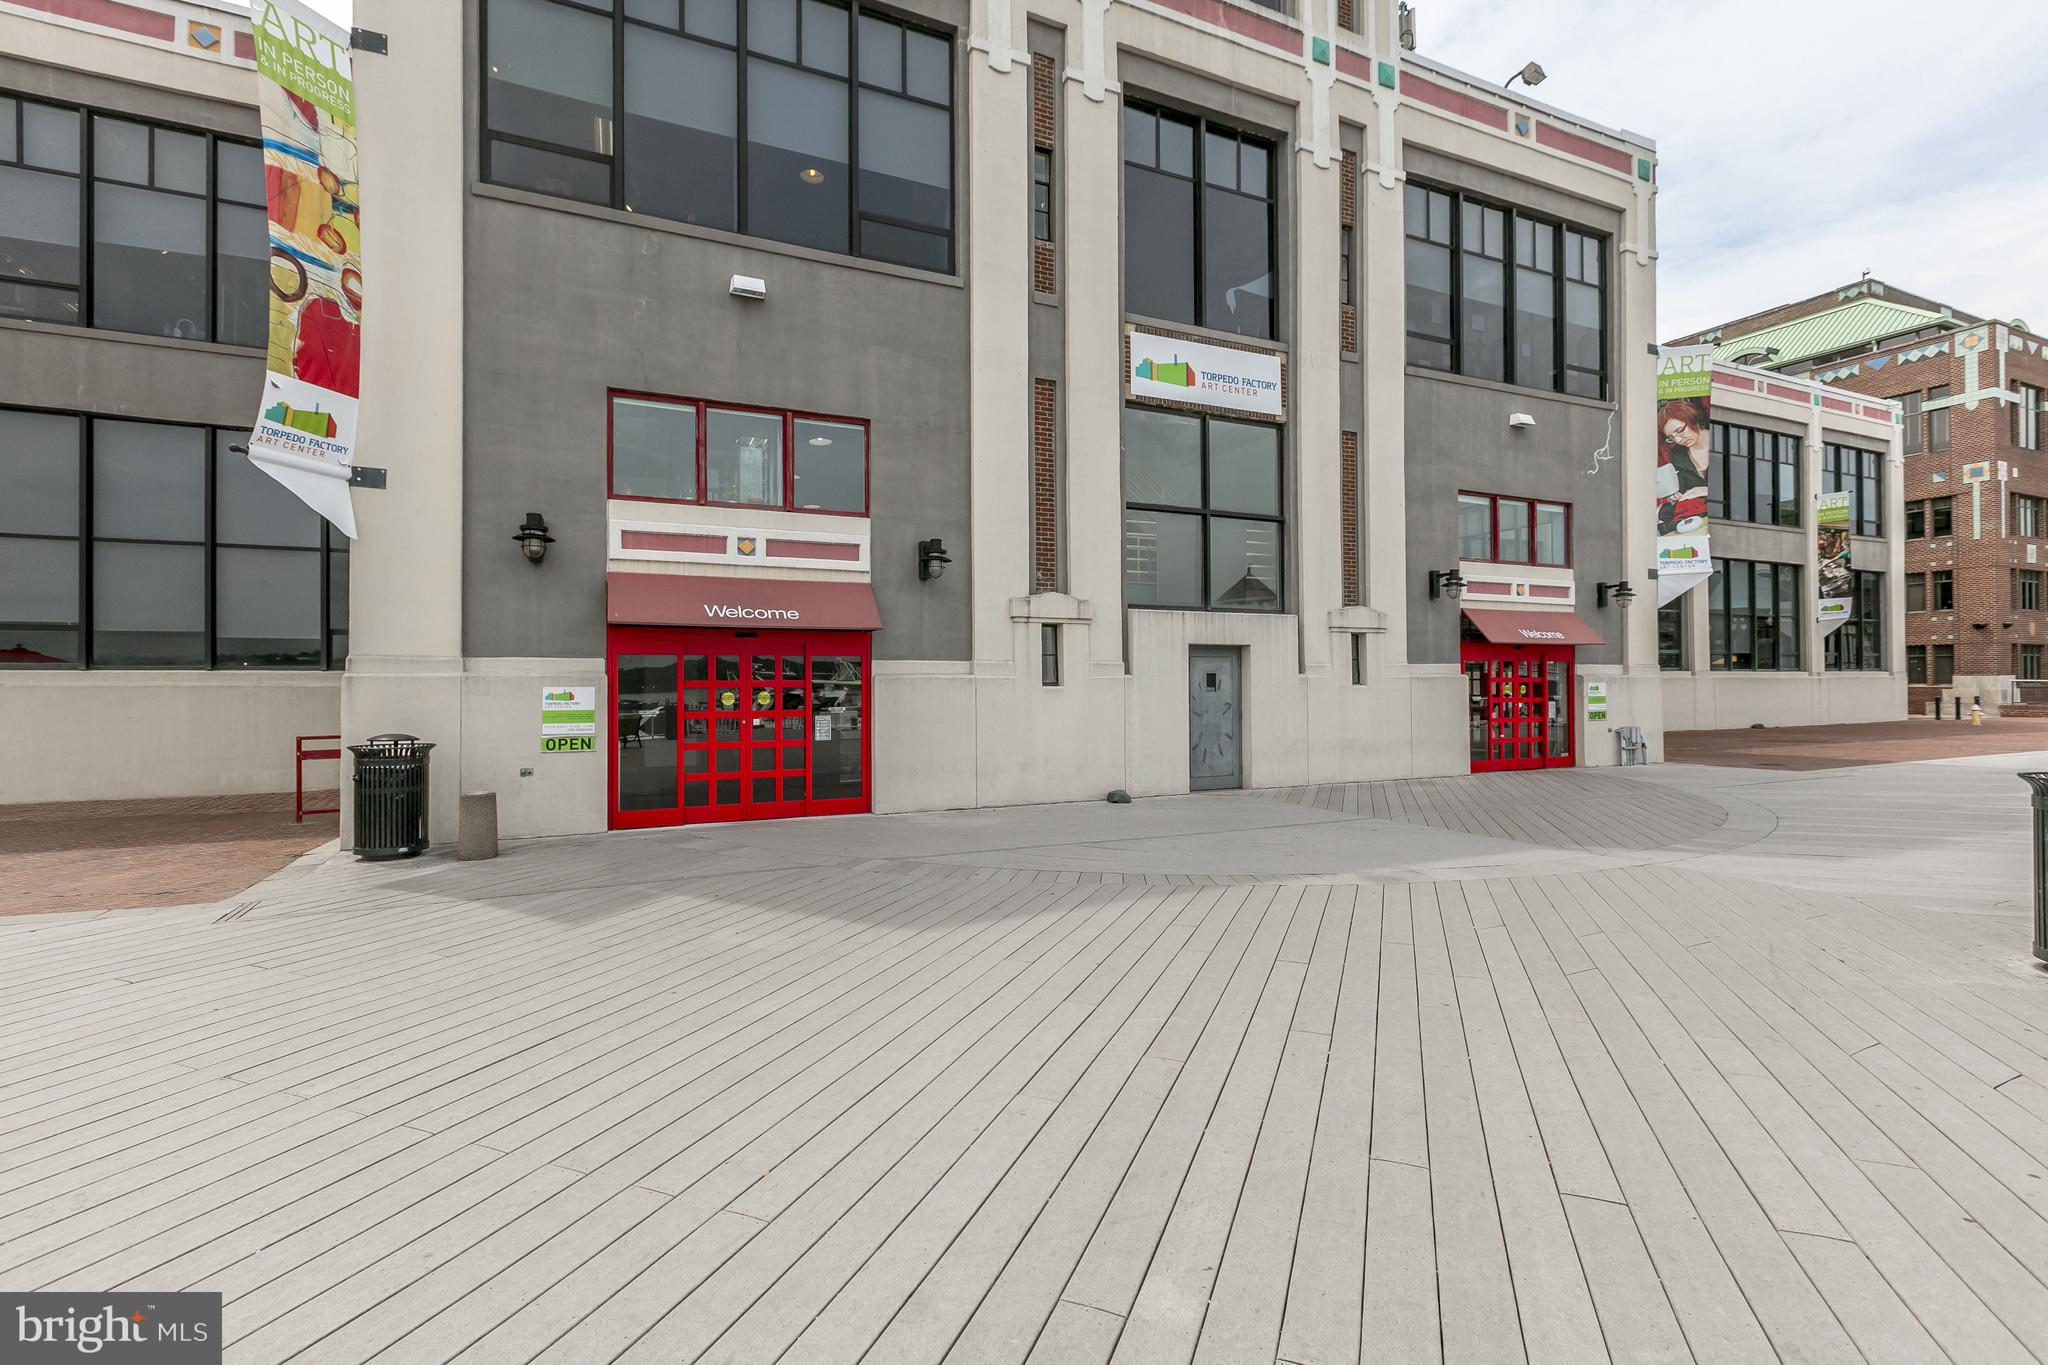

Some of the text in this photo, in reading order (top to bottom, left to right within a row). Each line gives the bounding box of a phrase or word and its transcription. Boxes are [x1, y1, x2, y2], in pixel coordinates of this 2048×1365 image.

[261, 0, 346, 71] ART
[258, 36, 351, 104] IN PERSON
[260, 54, 351, 114] & IN PROGRESS
[1661, 353, 1711, 375] ART
[1201, 371, 1278, 391] TORPEDO FACTORY
[1201, 382, 1258, 397] ART CENTER
[1672, 376, 1710, 386] PERSON
[256, 435, 326, 458] ART CENTER
[260, 425, 349, 455] TORPEDO FACTORY
[703, 604, 800, 620] Welcome
[1518, 629, 1565, 639] Welcome
[1589, 711, 1607, 720] OPEN
[545, 738, 592, 751] OPEN
